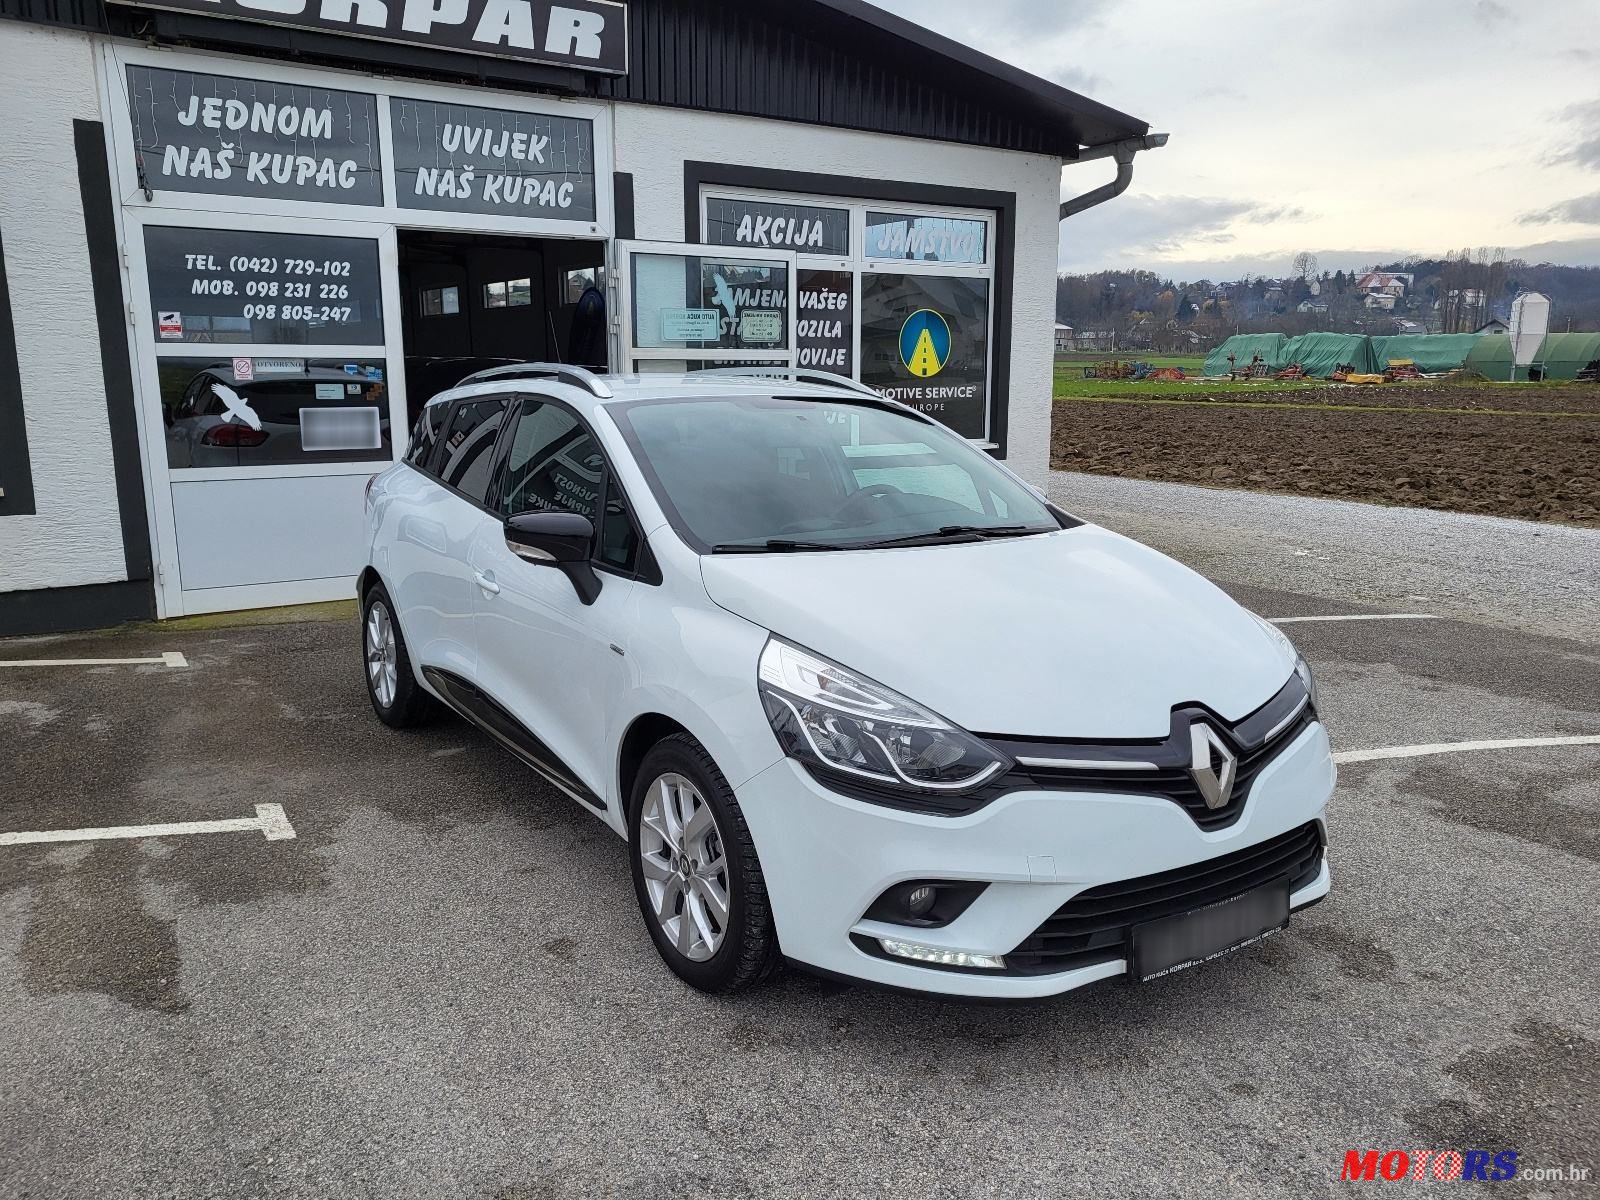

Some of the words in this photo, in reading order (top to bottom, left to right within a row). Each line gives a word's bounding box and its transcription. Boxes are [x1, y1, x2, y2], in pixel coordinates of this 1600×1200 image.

[178, 94, 333, 139] JEDNOM
[442, 123, 549, 165] UVIJEK
[161, 142, 235, 180] NAŠ
[246, 151, 358, 190] KUPAC
[414, 164, 475, 200] NAŠ
[482, 173, 574, 209] KUPAC
[735, 214, 824, 248] AKCIJA
[878, 227, 975, 257] JAMSTVO
[185, 254, 222, 272] TEL.
[229, 255, 278, 274] (042)
[284, 258, 351, 277] 729-102
[191, 279, 239, 296] MOB.
[245, 281, 279, 298] 098
[284, 282, 311, 299] 231
[319, 284, 349, 300] 226
[799, 287, 848, 310] VAŠEG
[243, 303, 277, 320] 098
[281, 305, 352, 322] 805-247
[796, 320, 842, 338] OZILA
[909, 403, 945, 411] UROPE
